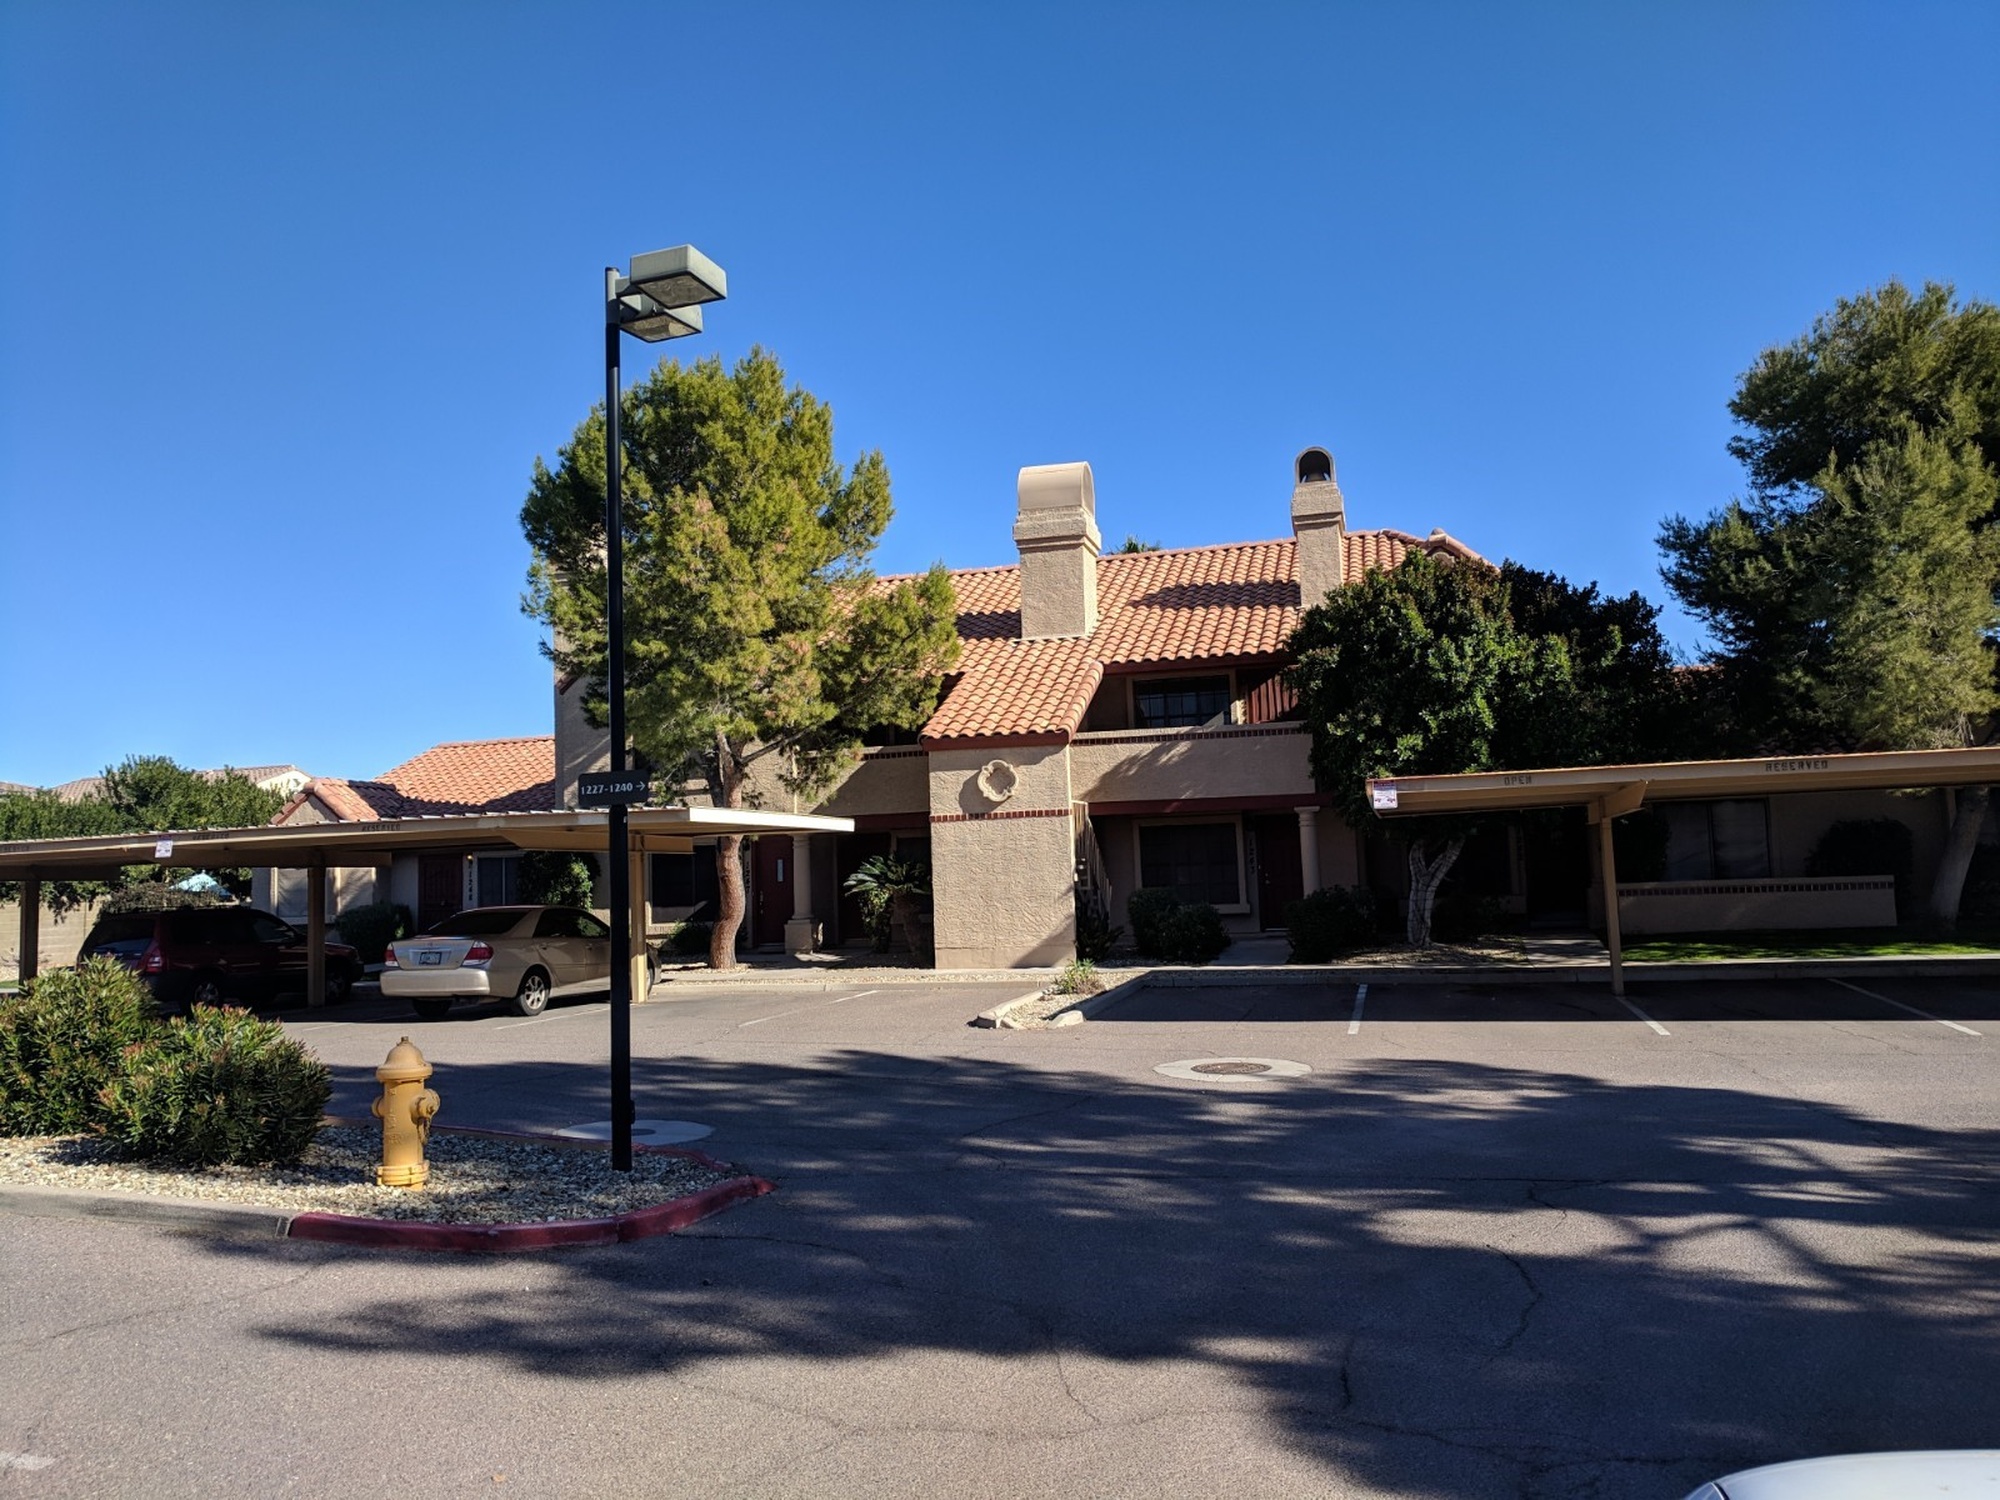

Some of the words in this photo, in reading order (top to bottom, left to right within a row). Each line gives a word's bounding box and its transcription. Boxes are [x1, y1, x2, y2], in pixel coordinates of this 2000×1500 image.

[1765, 760, 1829, 772] RESERVED
[1504, 775, 1532, 786] OPEN
[581, 782, 634, 796] 1227-1240
